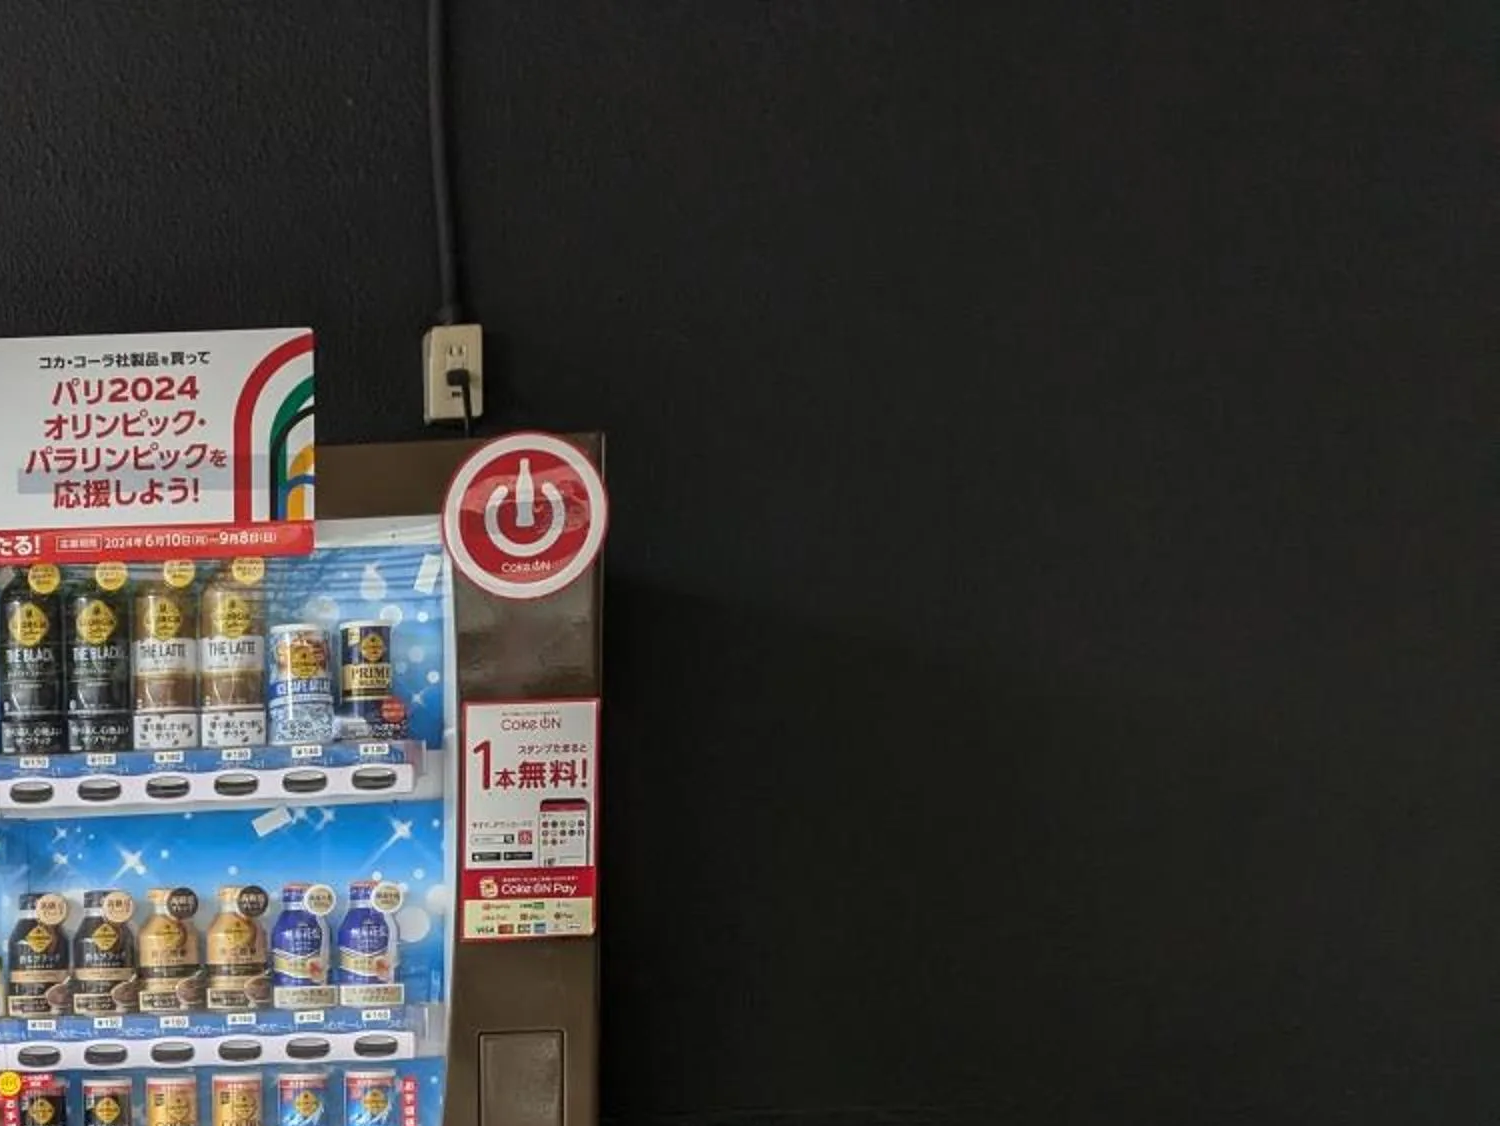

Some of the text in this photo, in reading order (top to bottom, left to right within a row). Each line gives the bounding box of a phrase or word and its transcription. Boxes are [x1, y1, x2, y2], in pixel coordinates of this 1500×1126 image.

[39, 351, 211, 369] コカ・コーラ社製品を買って
[52, 376, 199, 406] パリ2024
[44, 408, 206, 441] オリンピック・
[26, 442, 229, 474] パラリンピックを
[53, 477, 200, 509] 応援しよう!
[501, 718, 538, 731] Coke
[473, 740, 588, 790] 1本無料!
[502, 883, 532, 895] Coke
[553, 884, 577, 897] Pay
